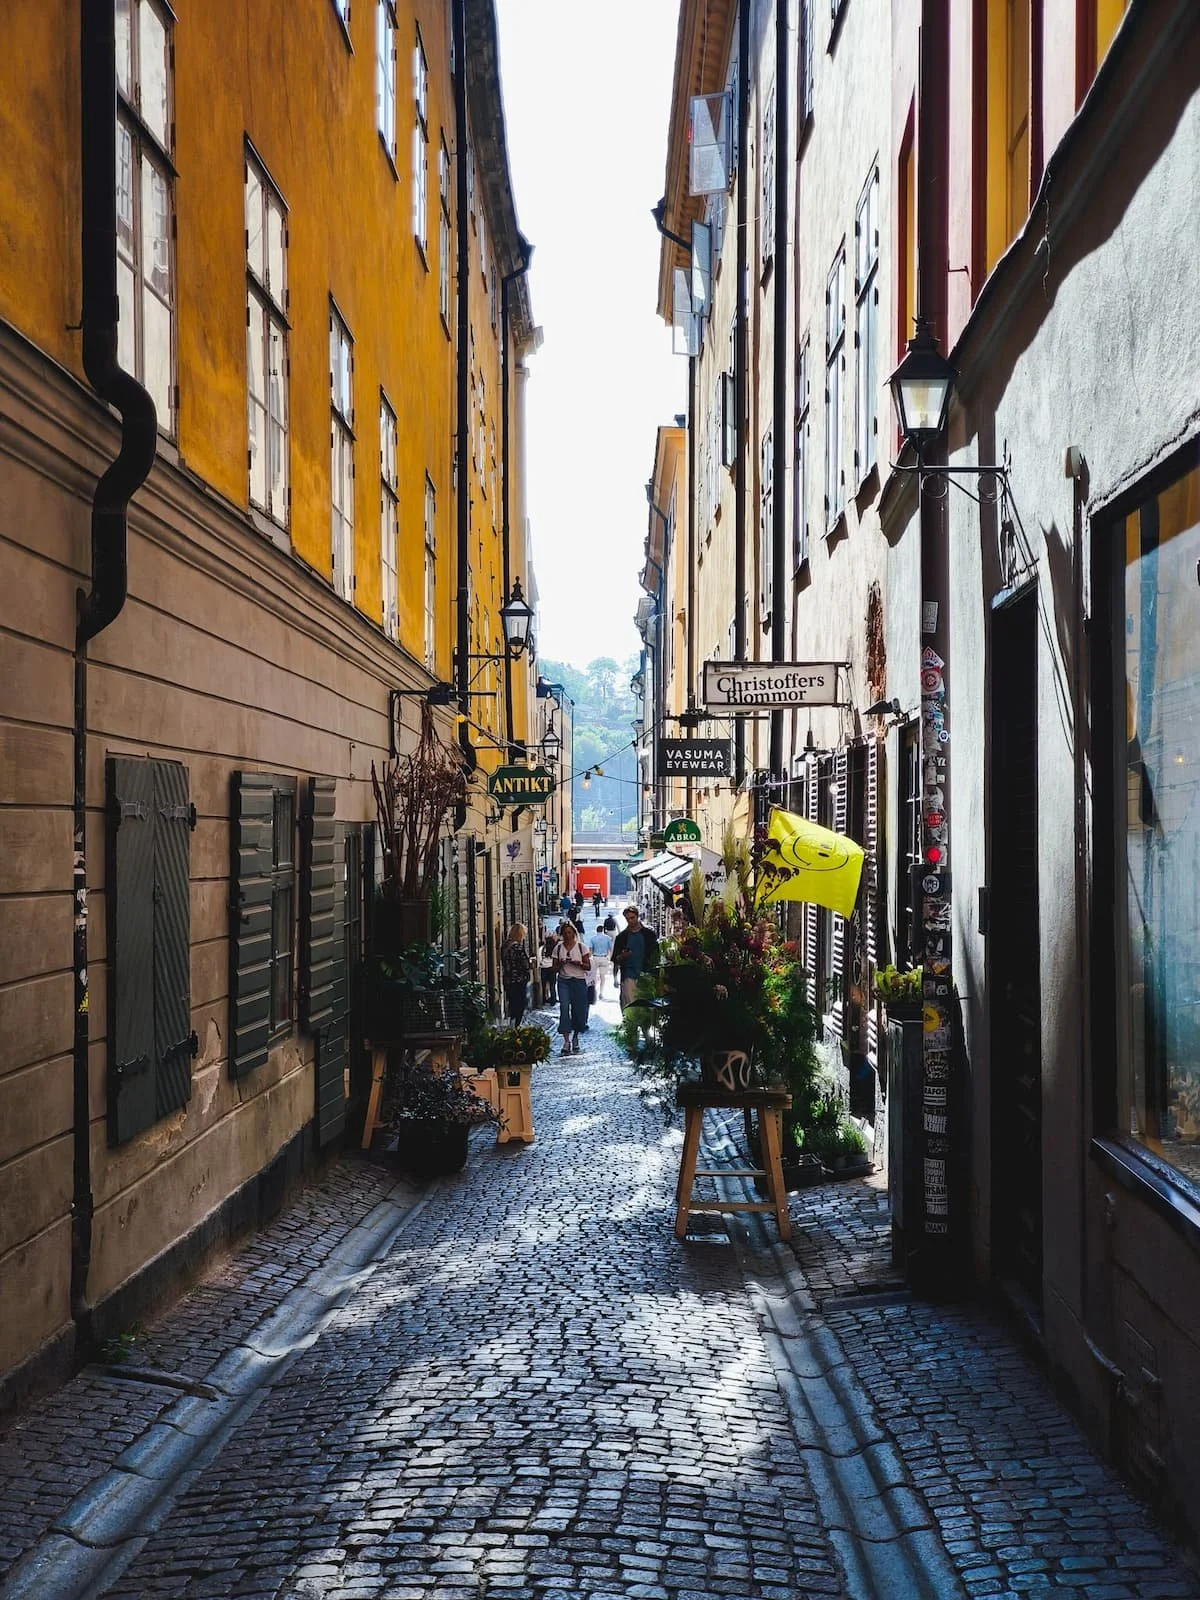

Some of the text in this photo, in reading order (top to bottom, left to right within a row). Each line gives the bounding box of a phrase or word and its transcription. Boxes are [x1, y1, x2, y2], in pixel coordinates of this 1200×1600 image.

[717, 673, 825, 693] Christoffers
[727, 689, 807, 704] Blommor
[666, 749, 724, 760] VASUMA
[666, 760, 724, 770] EYEWEAR
[493, 777, 552, 793] ANTIKT
